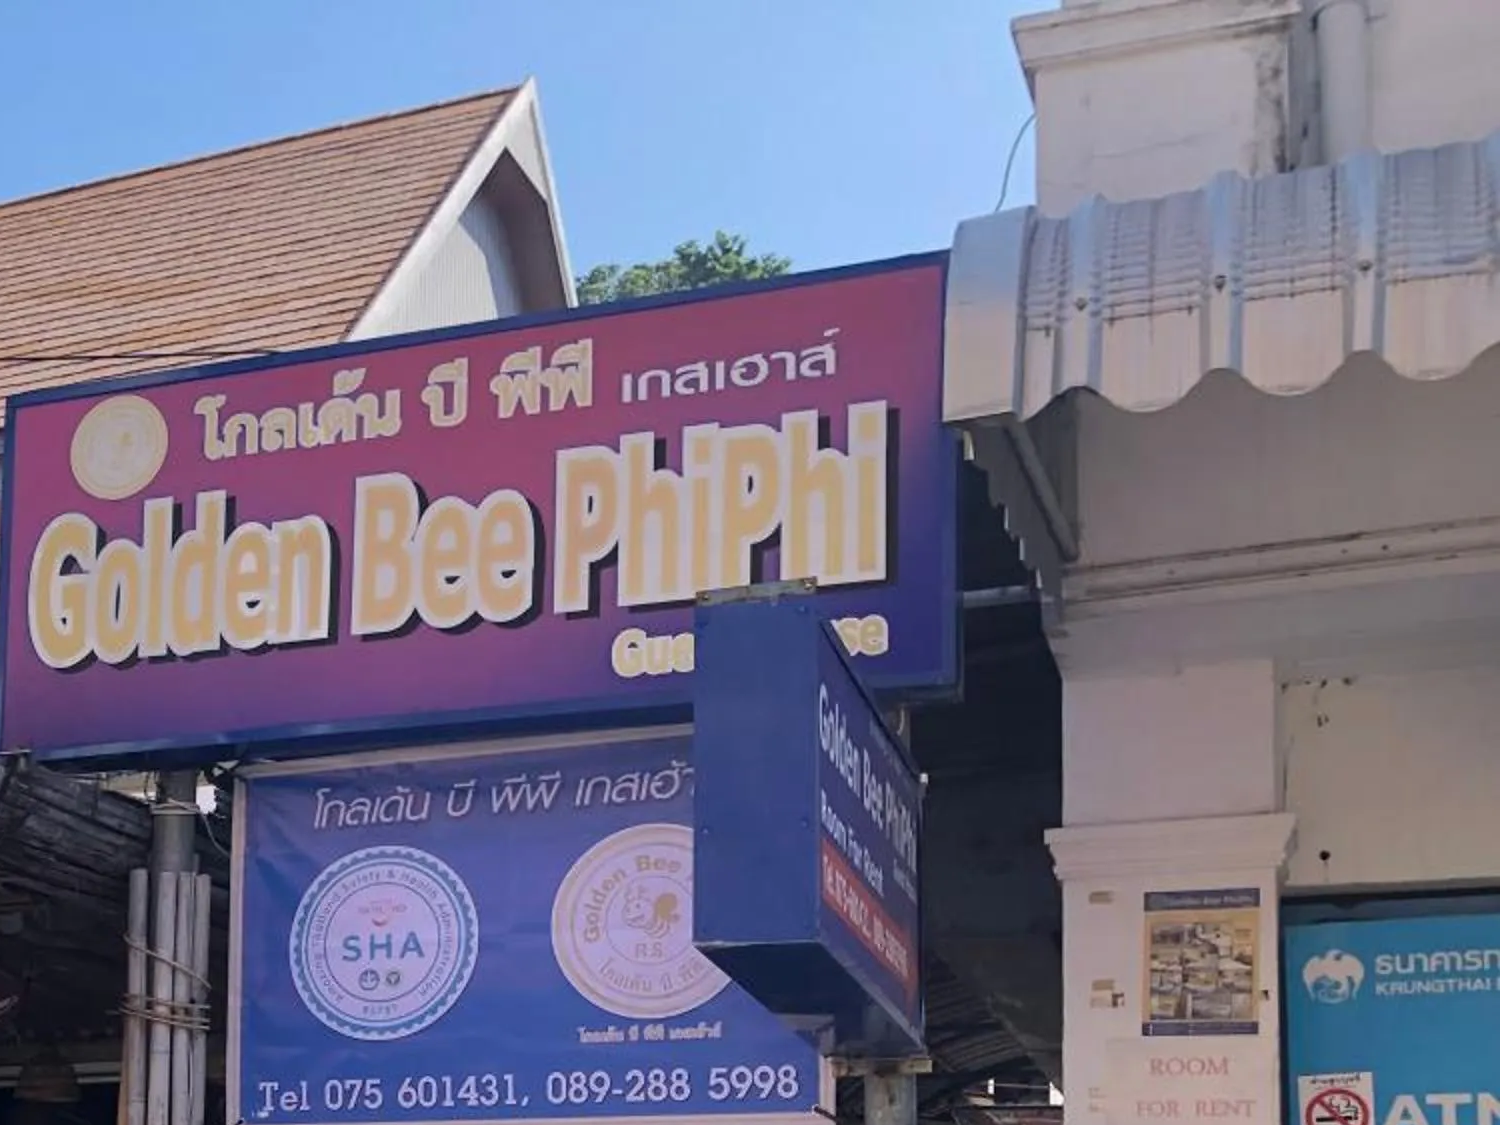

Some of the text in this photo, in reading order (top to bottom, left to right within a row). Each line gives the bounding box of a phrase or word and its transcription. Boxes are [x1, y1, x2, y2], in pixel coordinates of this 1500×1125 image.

[29, 400, 888, 669] Golden Bee PhiPhi
[613, 628, 695, 677] Gue
[819, 682, 861, 798] Golden
[862, 747, 884, 830] Bee
[314, 786, 431, 829] โกลเด้น
[635, 855, 682, 873] Bee
[342, 931, 425, 962] SHA
[1375, 978, 1491, 995] KRUNGTHAI
[1149, 1058, 1229, 1077] ROOM
[258, 1065, 799, 1113] Tel 075 601431, 089-288 5998
[1136, 1100, 1257, 1119] FOR RENT
